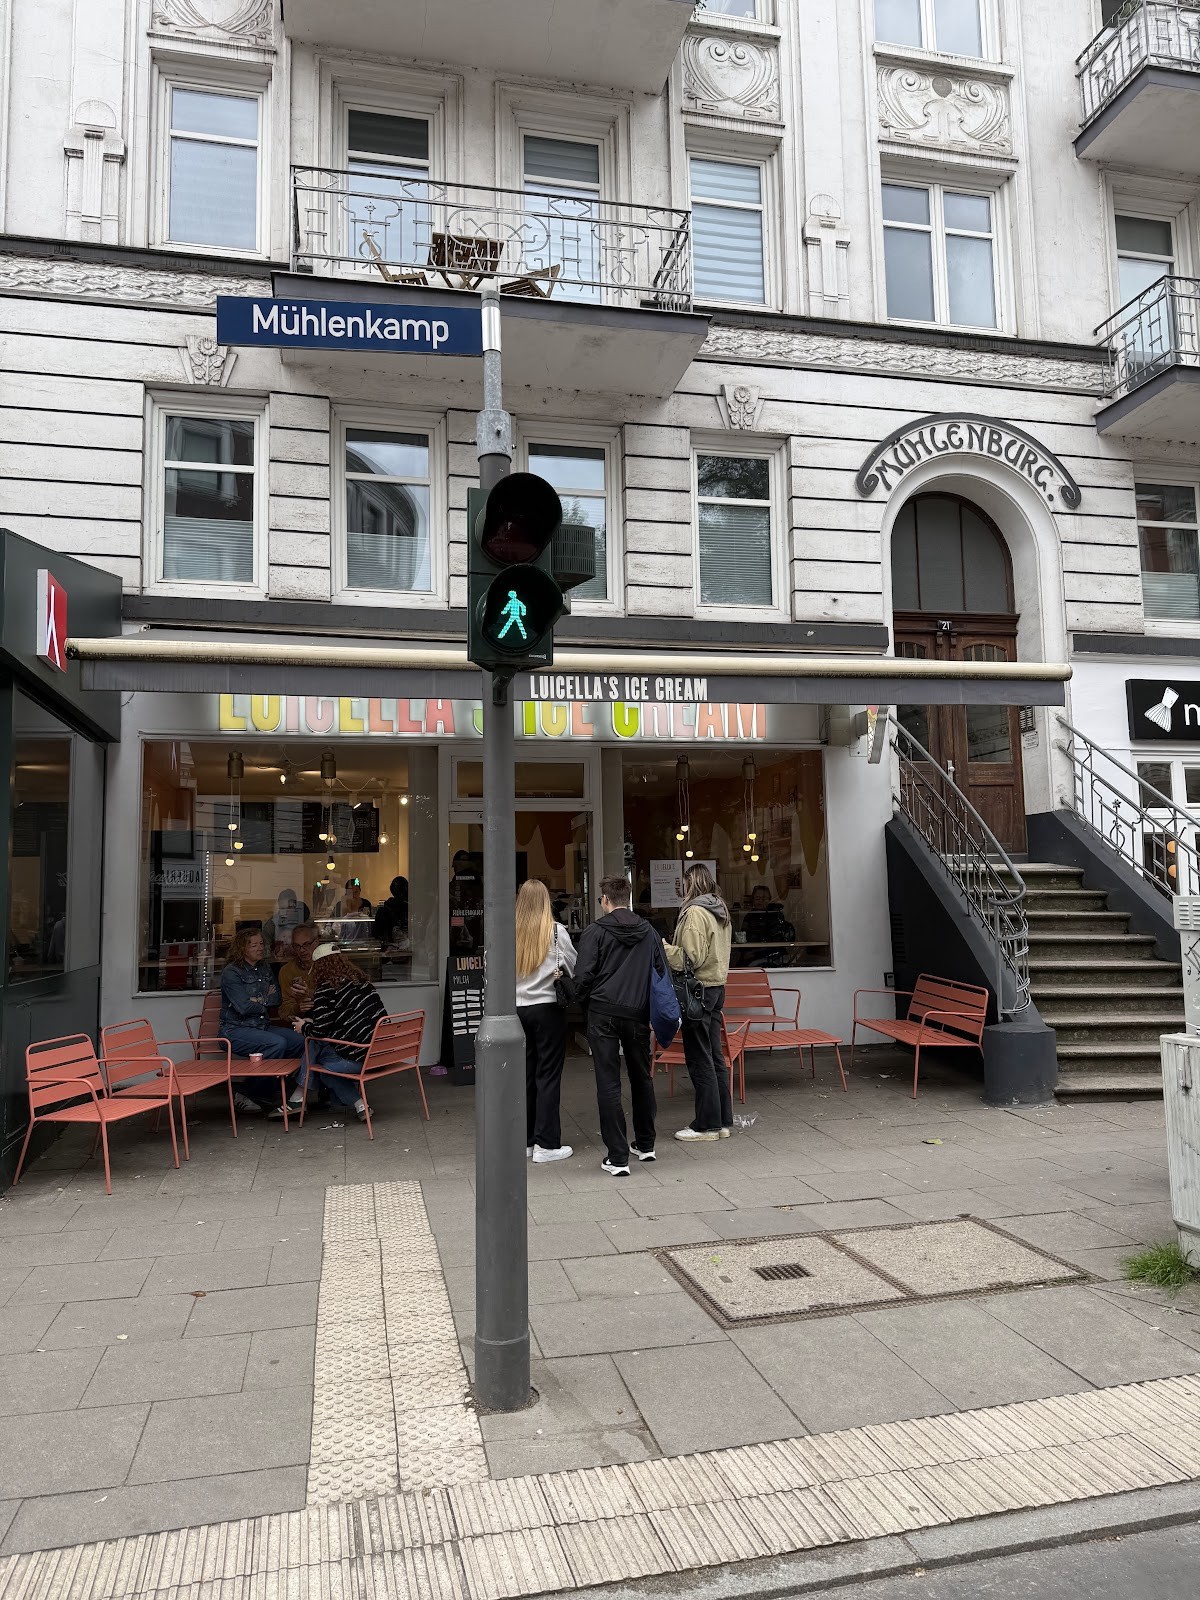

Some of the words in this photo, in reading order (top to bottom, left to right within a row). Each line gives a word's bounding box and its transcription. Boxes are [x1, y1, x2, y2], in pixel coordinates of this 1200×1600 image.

[252, 303, 449, 349] Mühlenkamp
[941, 620, 950, 631] 21
[529, 675, 620, 700] LUICELLA'S
[625, 676, 649, 700] ICE
[655, 678, 708, 701] CREAM
[218, 694, 483, 735] LUICELLA
[522, 701, 594, 737] ICE
[611, 702, 767, 738] CREAM
[456, 956, 483, 971] LUICEL
